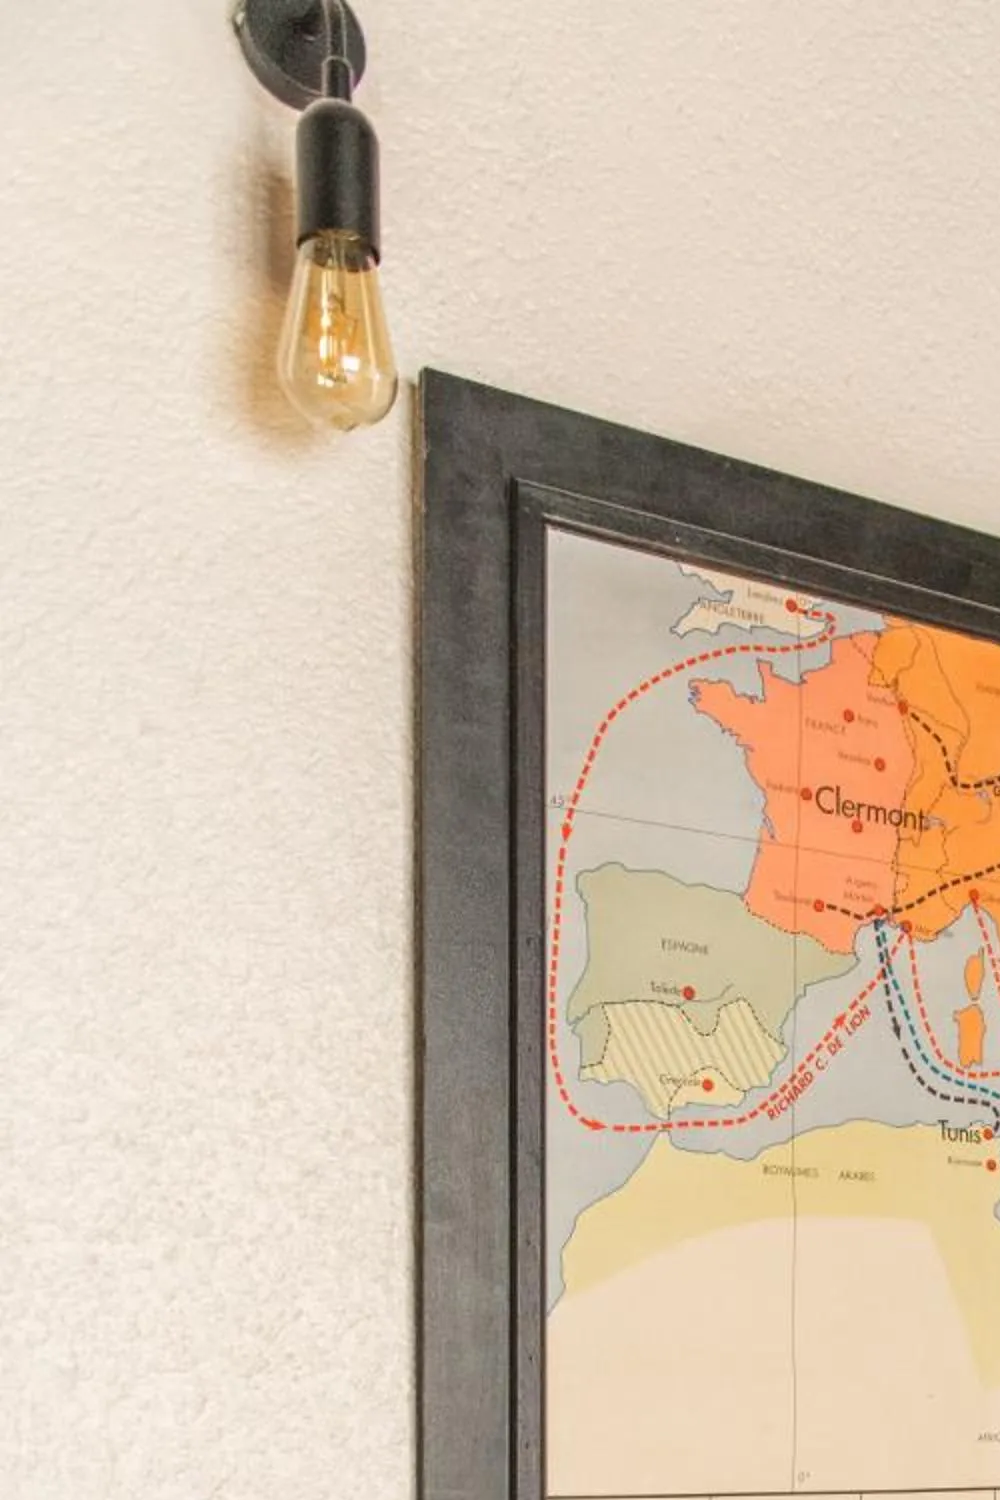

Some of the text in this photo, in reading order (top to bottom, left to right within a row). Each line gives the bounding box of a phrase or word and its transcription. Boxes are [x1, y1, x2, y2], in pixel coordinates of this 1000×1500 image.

[815, 785, 925, 830] Clermont
[766, 1071, 815, 1122] RICHARD
[938, 1119, 982, 1144] Tunis
